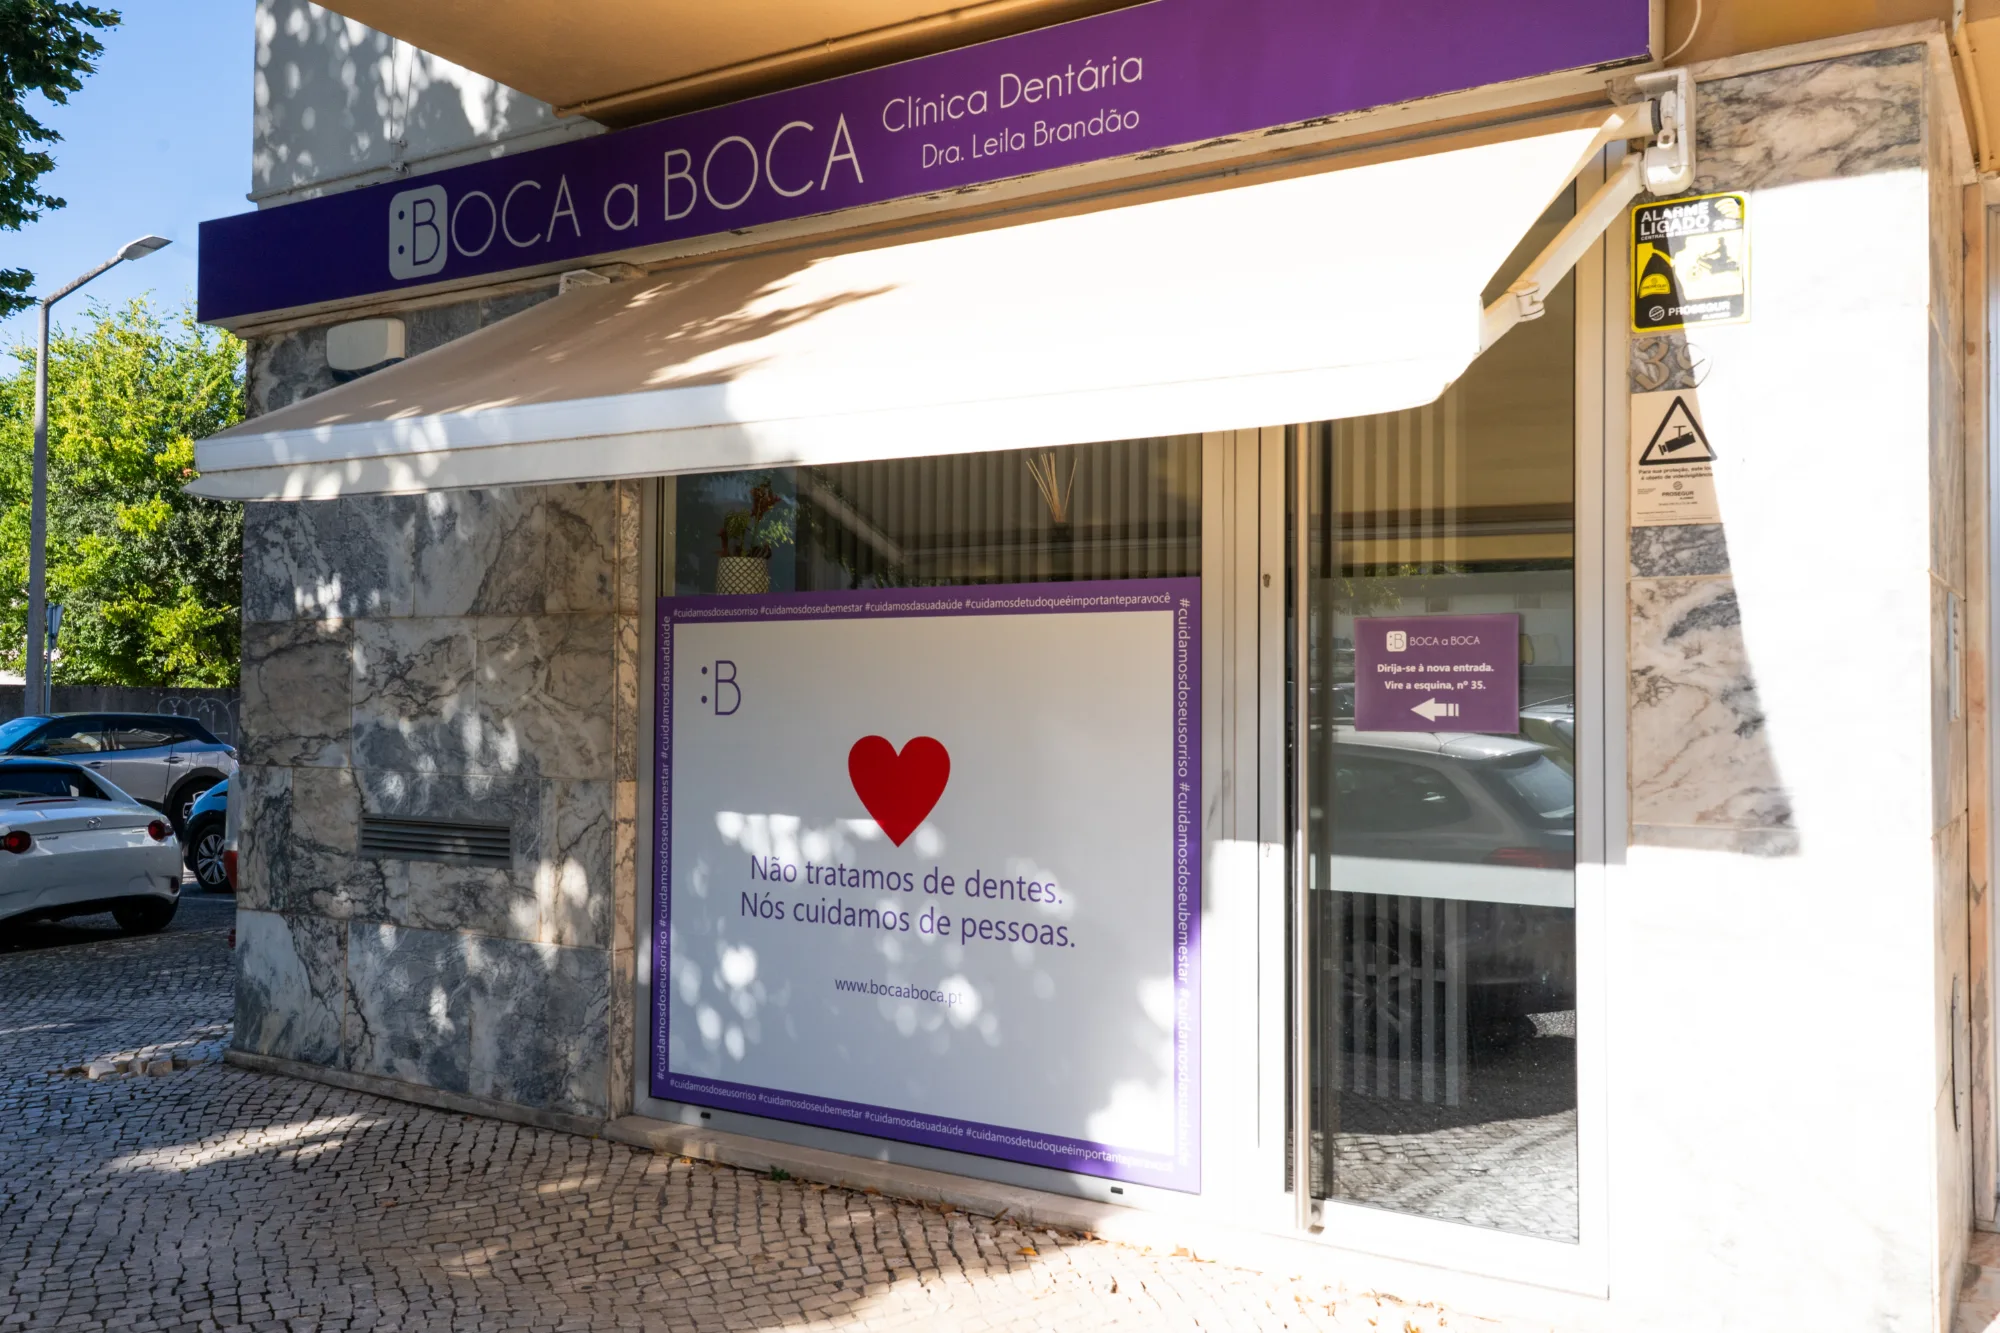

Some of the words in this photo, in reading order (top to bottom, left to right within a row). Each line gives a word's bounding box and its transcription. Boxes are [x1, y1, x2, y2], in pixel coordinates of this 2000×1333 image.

[882, 88, 988, 133] Clínica
[1000, 55, 1144, 109] Dentária
[922, 142, 965, 169] Dra.
[972, 128, 1026, 159] Leila
[1033, 108, 1140, 146] Brandão
[603, 182, 639, 231] a
[664, 112, 864, 222] BOCA
[1640, 214, 1710, 236] LIGADO
[1641, 201, 1710, 223] ALARME
[673, 605, 759, 618] #cuidamosdoseusorriso
[760, 603, 862, 616] #cuidamosdoseubemestar
[864, 599, 963, 612] #cuidamosdasuadaúde
[964, 592, 1171, 610] #cuidamosdetudoqueéimportanteparavocê
[1377, 664, 1416, 675] Dirija-se
[1418, 663, 1425, 672] à
[1453, 662, 1494, 672] entrada.
[1409, 636, 1439, 647] BOCA
[1451, 635, 1481, 646] BOCA
[661, 615, 672, 759] #cuidamosdasuadaúde
[1177, 597, 1191, 777] #cuidamosdoseusorriso
[1384, 681, 1404, 690] Vire
[1414, 681, 1454, 692] esquina,
[1457, 681, 1469, 690] nº
[1471, 681, 1486, 690] 35.
[659, 764, 670, 928] #cuidamosdoseubemestar
[750, 855, 797, 883] Não
[806, 861, 914, 892] tratamos
[923, 867, 955, 895] de
[965, 870, 1064, 904] dentes.
[1177, 781, 1191, 984] #cuidamosdoseubemestar
[741, 891, 785, 920] Nós
[793, 898, 910, 932] cuidamos
[919, 906, 951, 936] de
[960, 914, 1076, 948] pessoas.
[656, 930, 668, 1080] #cuidamosdoseusorriso
[834, 978, 964, 1008] www.bocaaboca.pt
[669, 1078, 757, 1102] #cuidamosdoseusorriso
[758, 1093, 863, 1119] #cuidamosdoseubemestar
[864, 1110, 964, 1137] #cuidamosdasuadaúde
